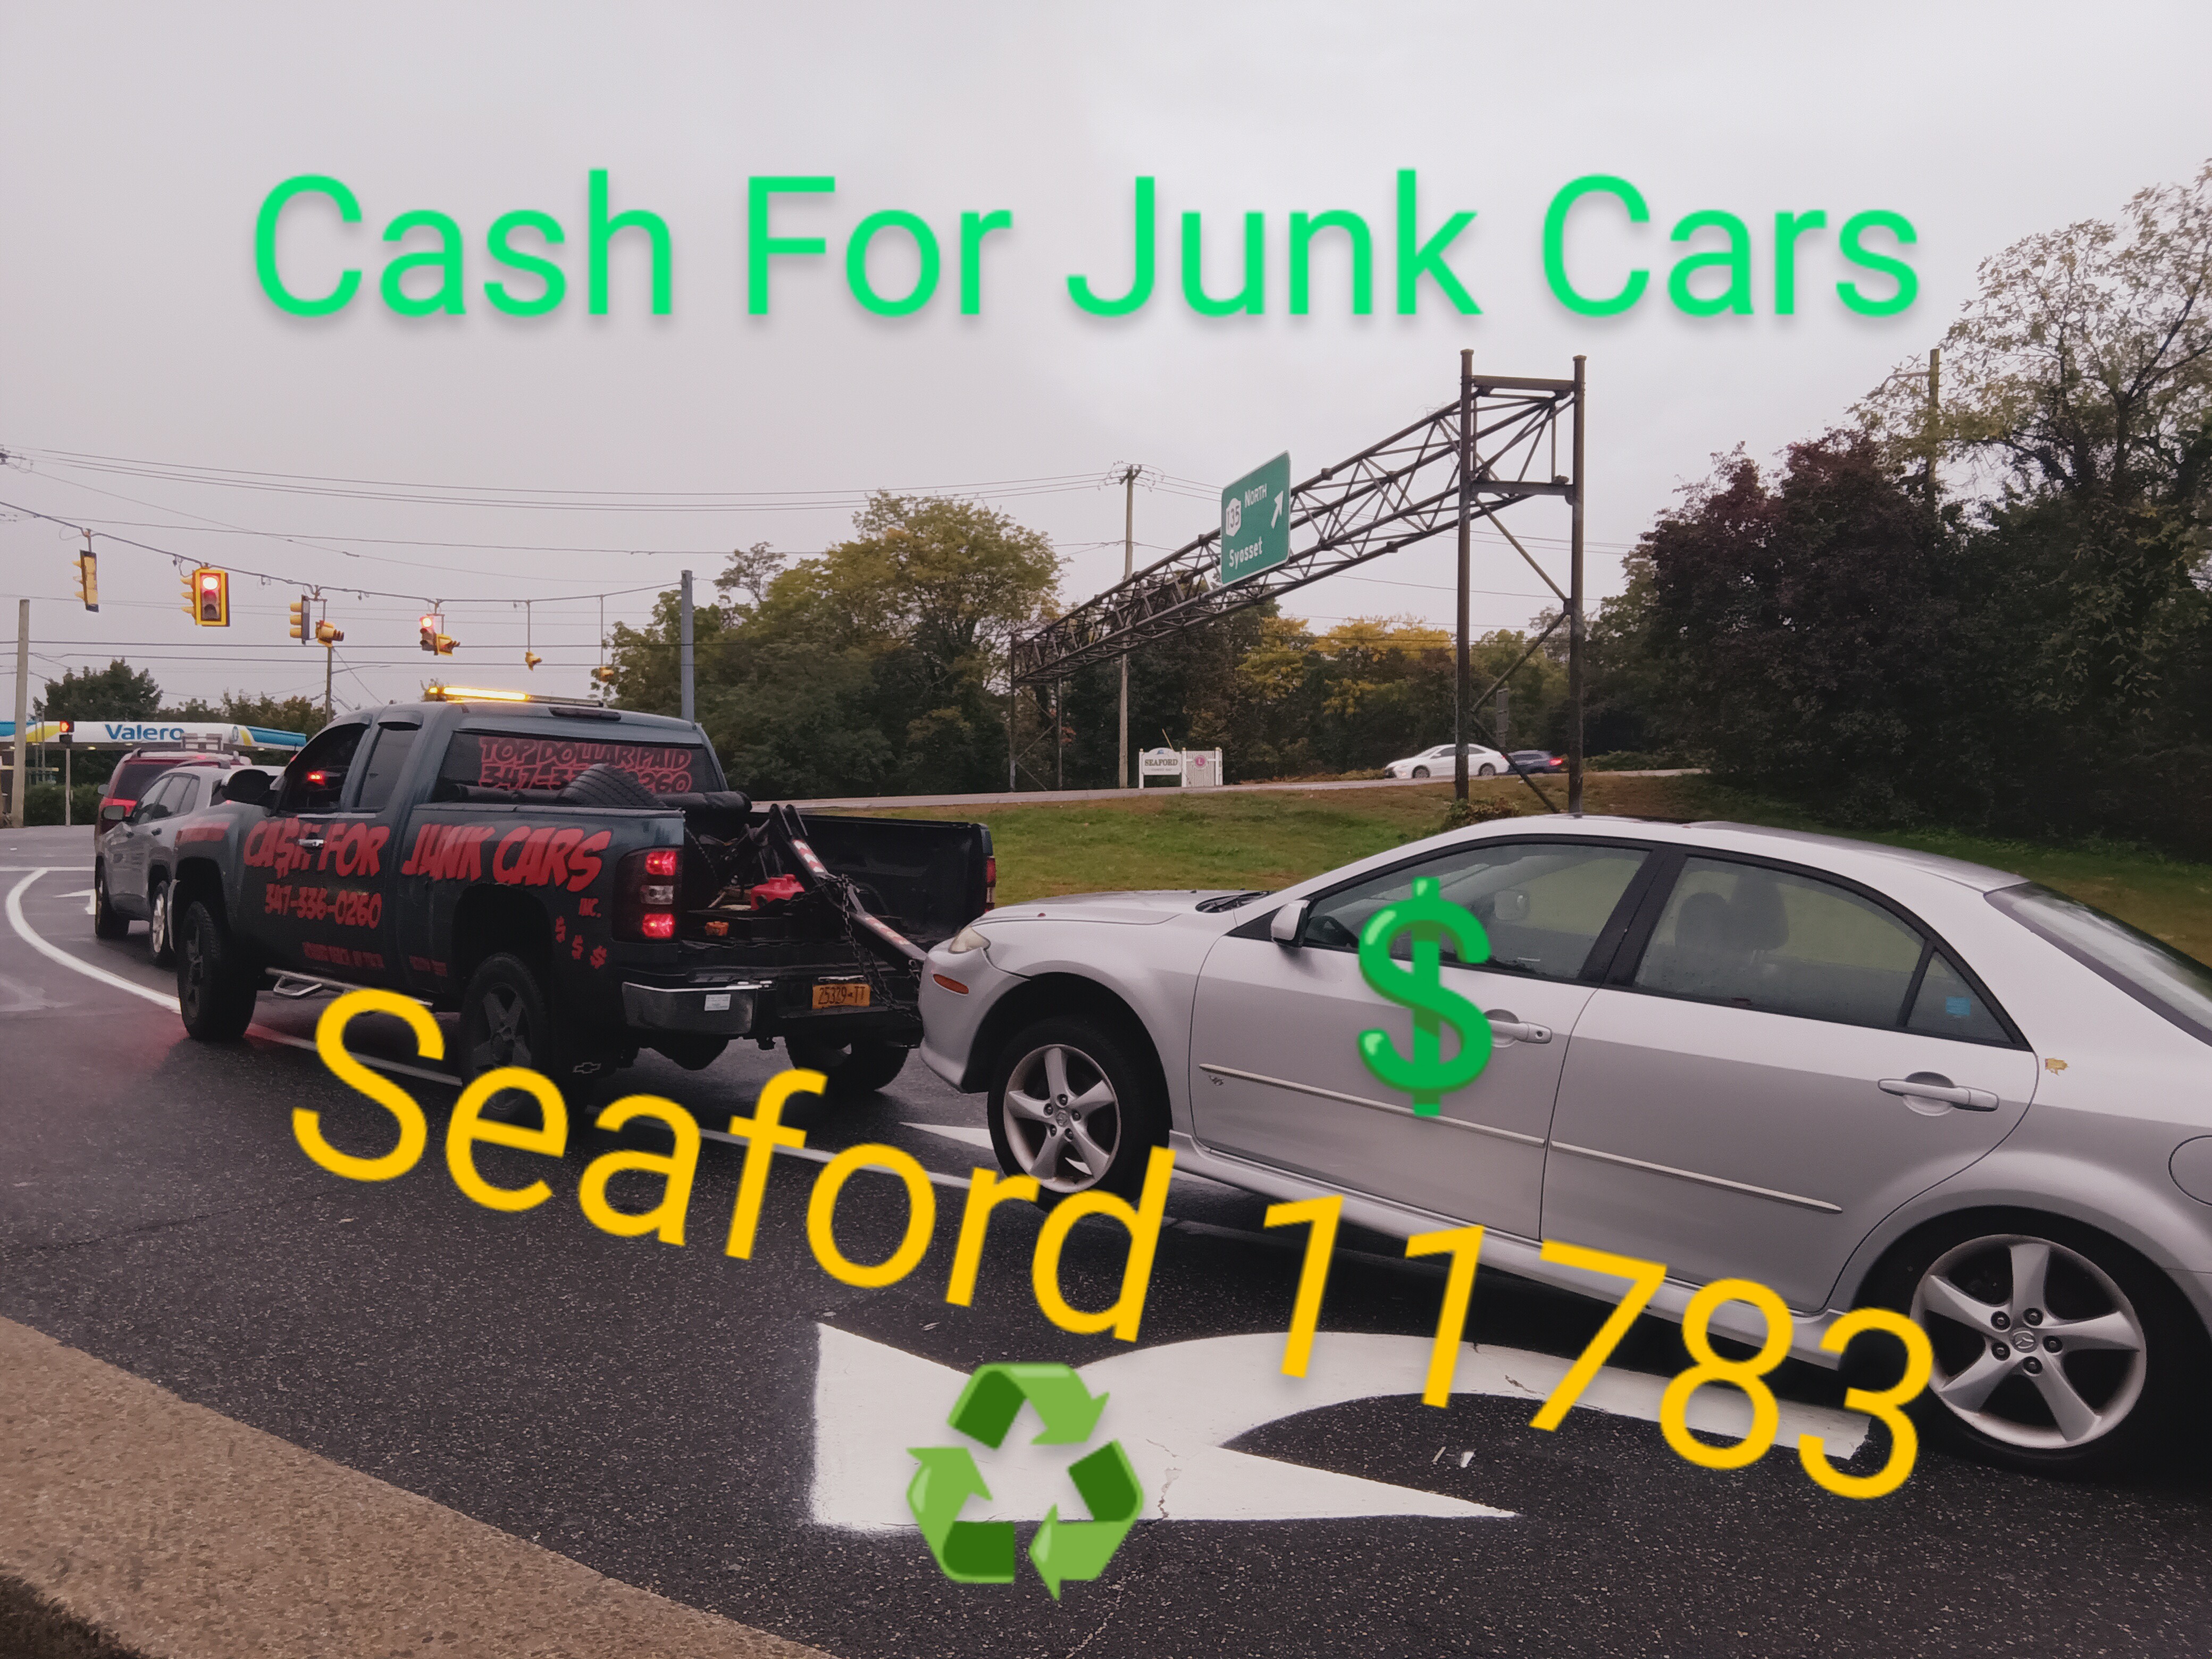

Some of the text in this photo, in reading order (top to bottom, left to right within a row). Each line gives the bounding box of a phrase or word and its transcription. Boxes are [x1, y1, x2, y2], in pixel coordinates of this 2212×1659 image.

[1244, 483, 1268, 508] NORTH
[1226, 505, 1240, 531] 135
[1228, 535, 1263, 570] Syosset
[105, 724, 185, 741] Valero
[478, 736, 692, 772] TOP DOLLAR PAID
[316, 823, 391, 876] FOR
[401, 824, 496, 881] JUNK
[492, 826, 611, 892] CARS
